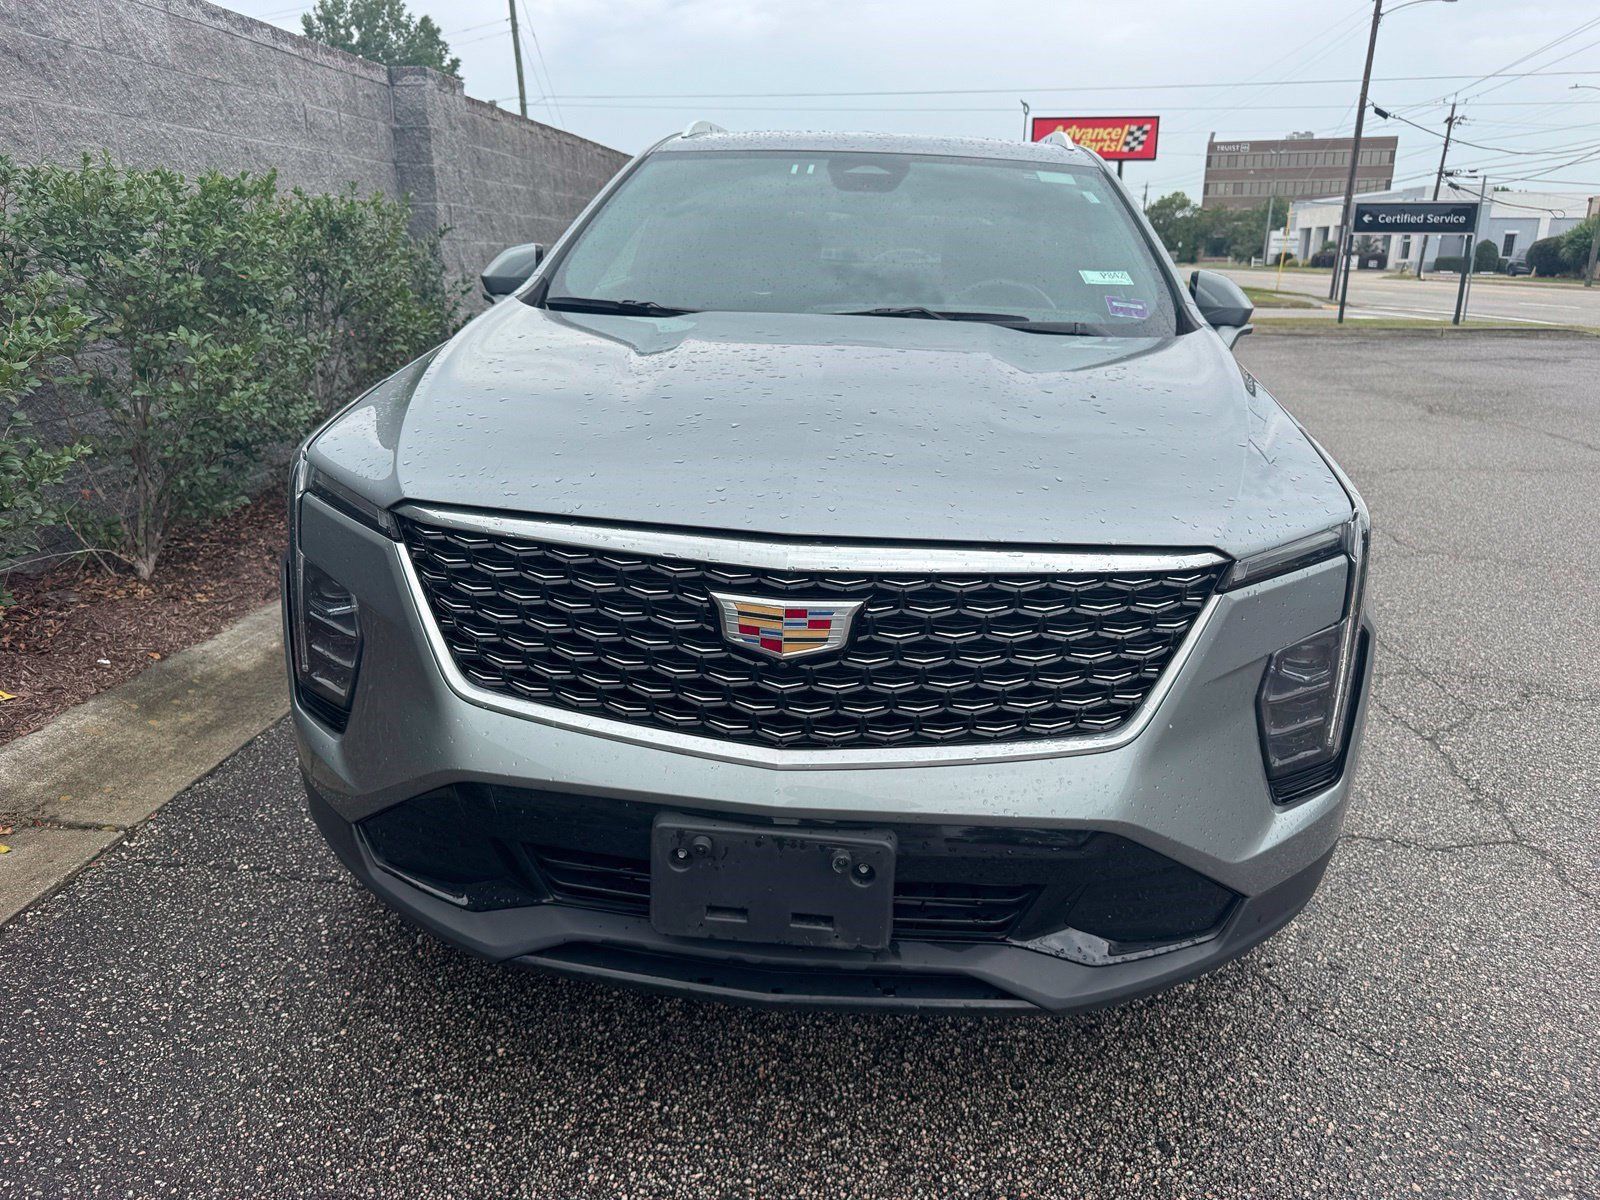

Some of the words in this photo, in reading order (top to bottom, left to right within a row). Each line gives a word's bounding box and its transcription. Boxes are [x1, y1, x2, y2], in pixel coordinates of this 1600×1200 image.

[1079, 140, 1118, 152] Parts
[1216, 144, 1240, 152] TRUIST
[1378, 214, 1424, 224] Certified
[1426, 214, 1466, 224] Service
